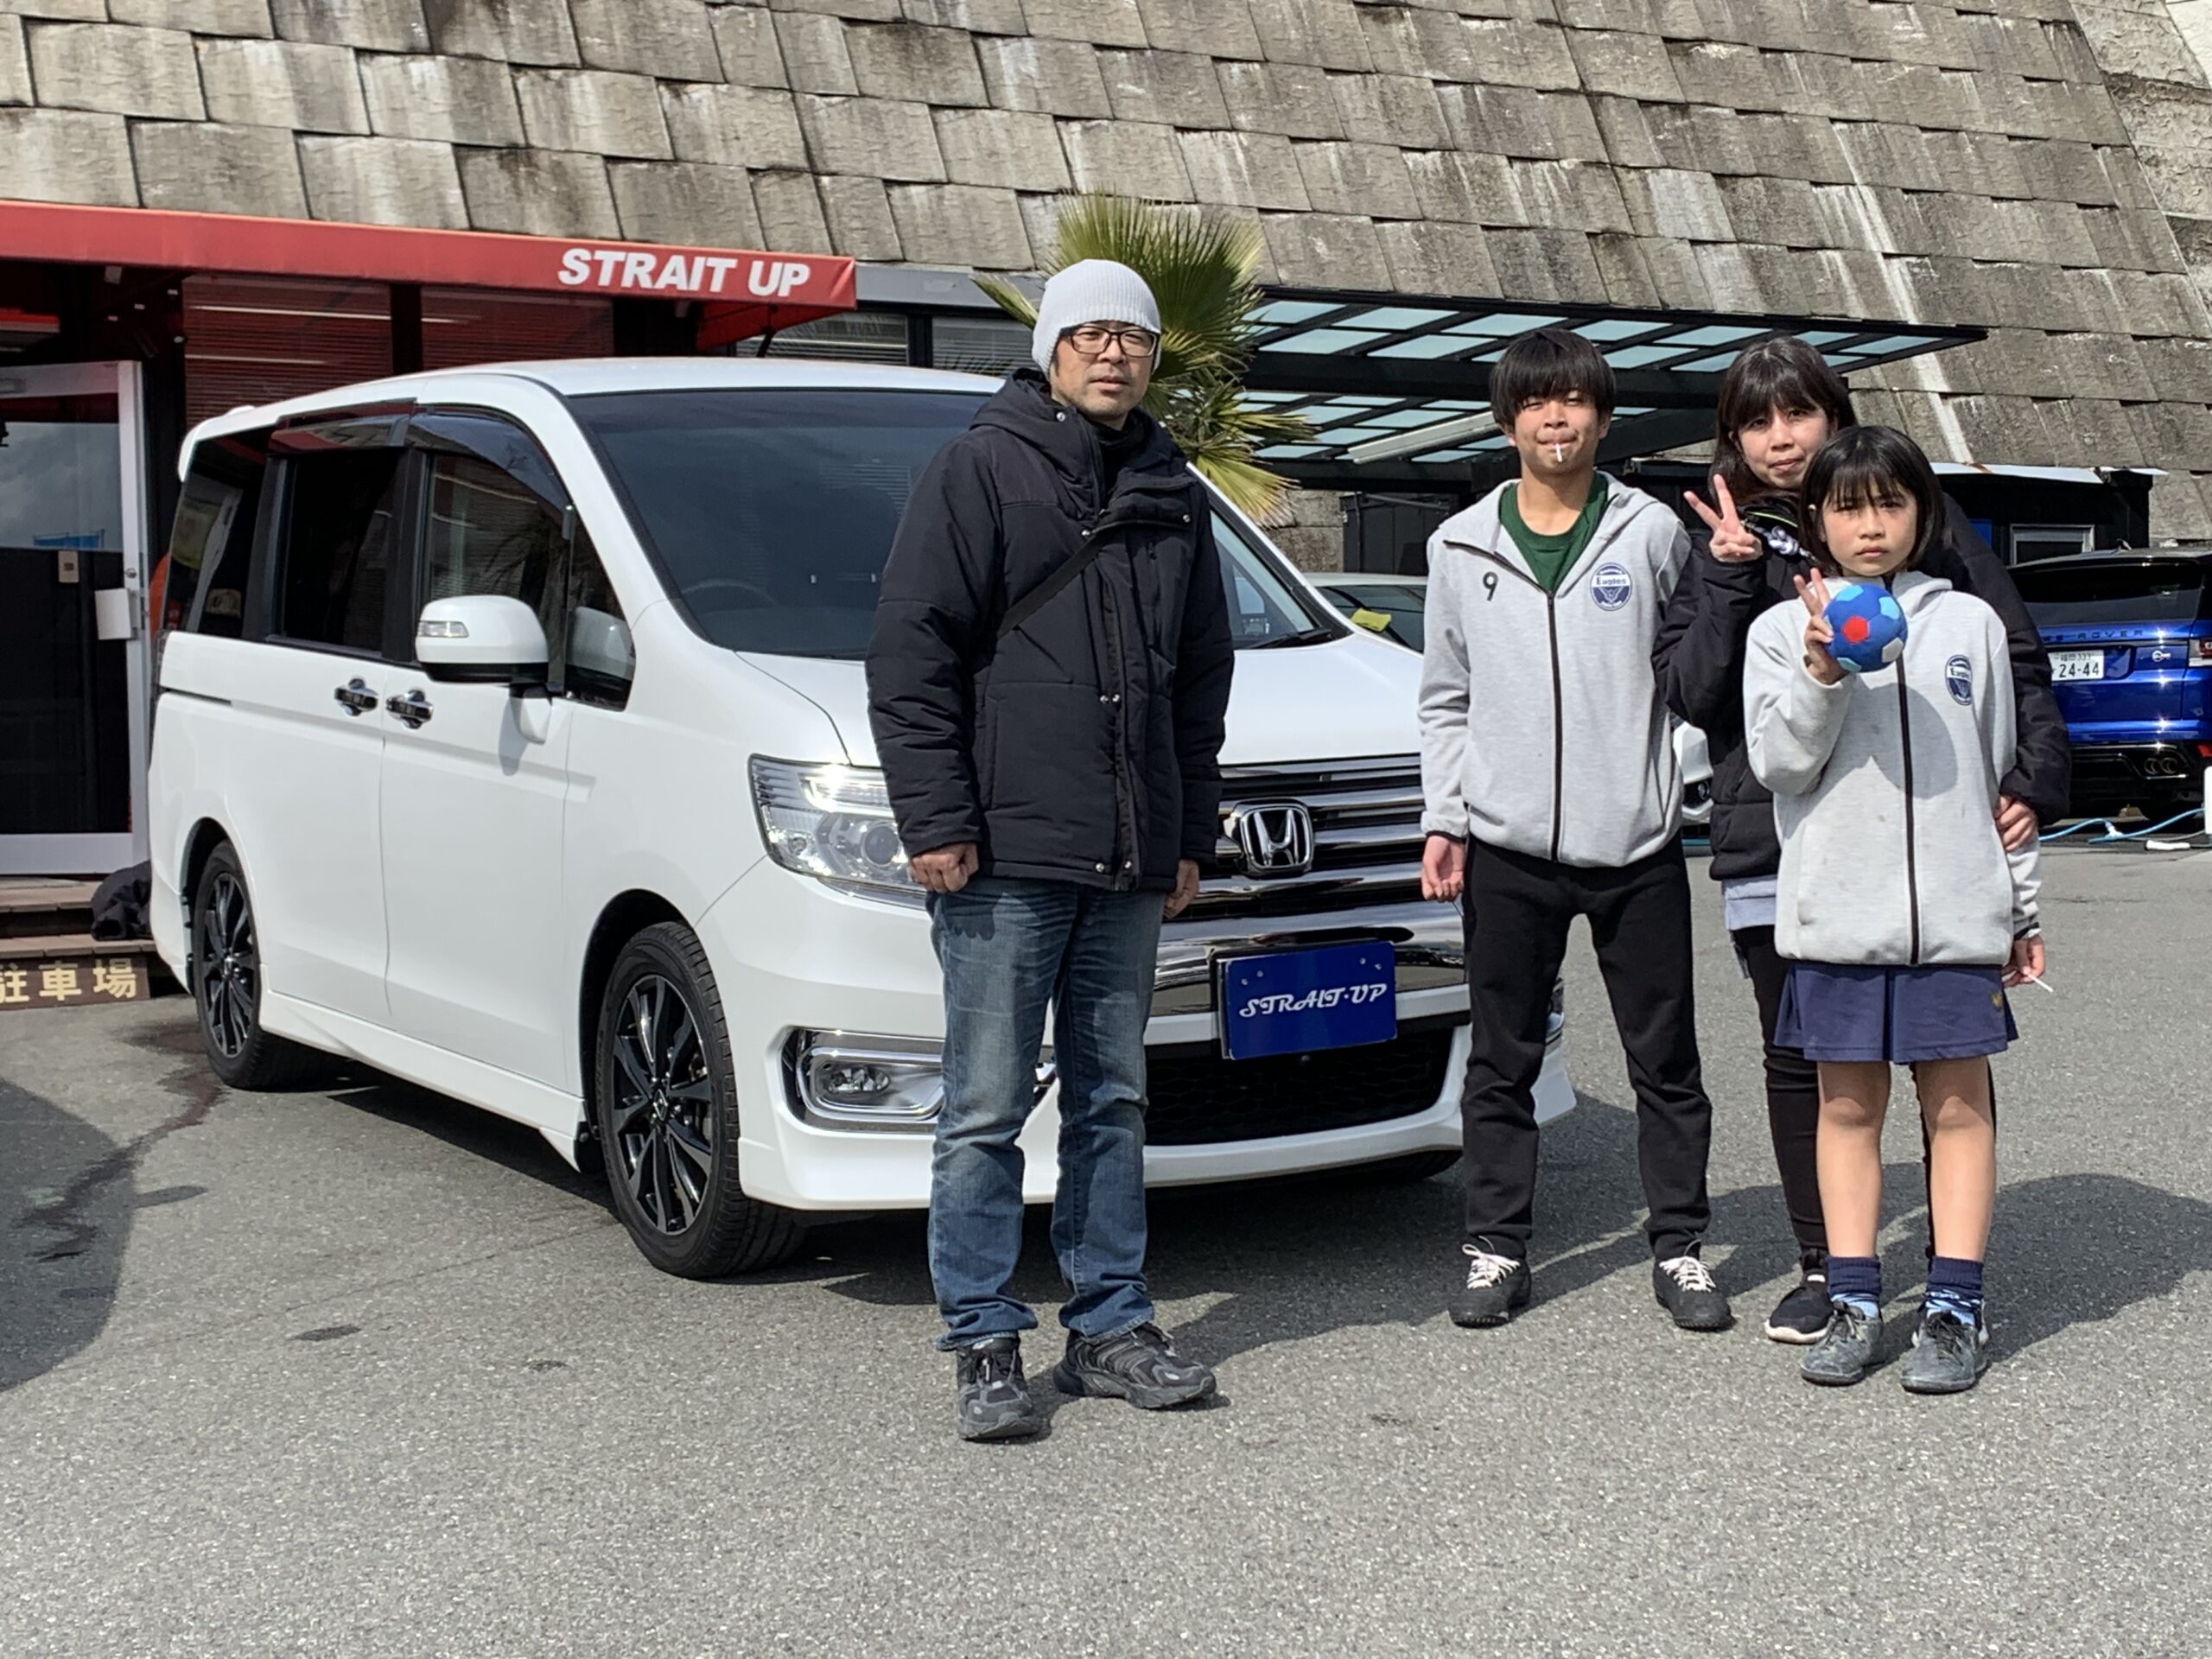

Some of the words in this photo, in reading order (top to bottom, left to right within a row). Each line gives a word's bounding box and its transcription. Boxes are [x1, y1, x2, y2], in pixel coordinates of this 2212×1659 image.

[557, 247, 738, 293] STRAIT
[747, 260, 810, 297] UP
[1483, 571, 1499, 601] 9
[2077, 629, 2143, 639] ROVER
[2058, 662, 2100, 678] 24-44
[0, 957, 137, 1003] 駐車場
